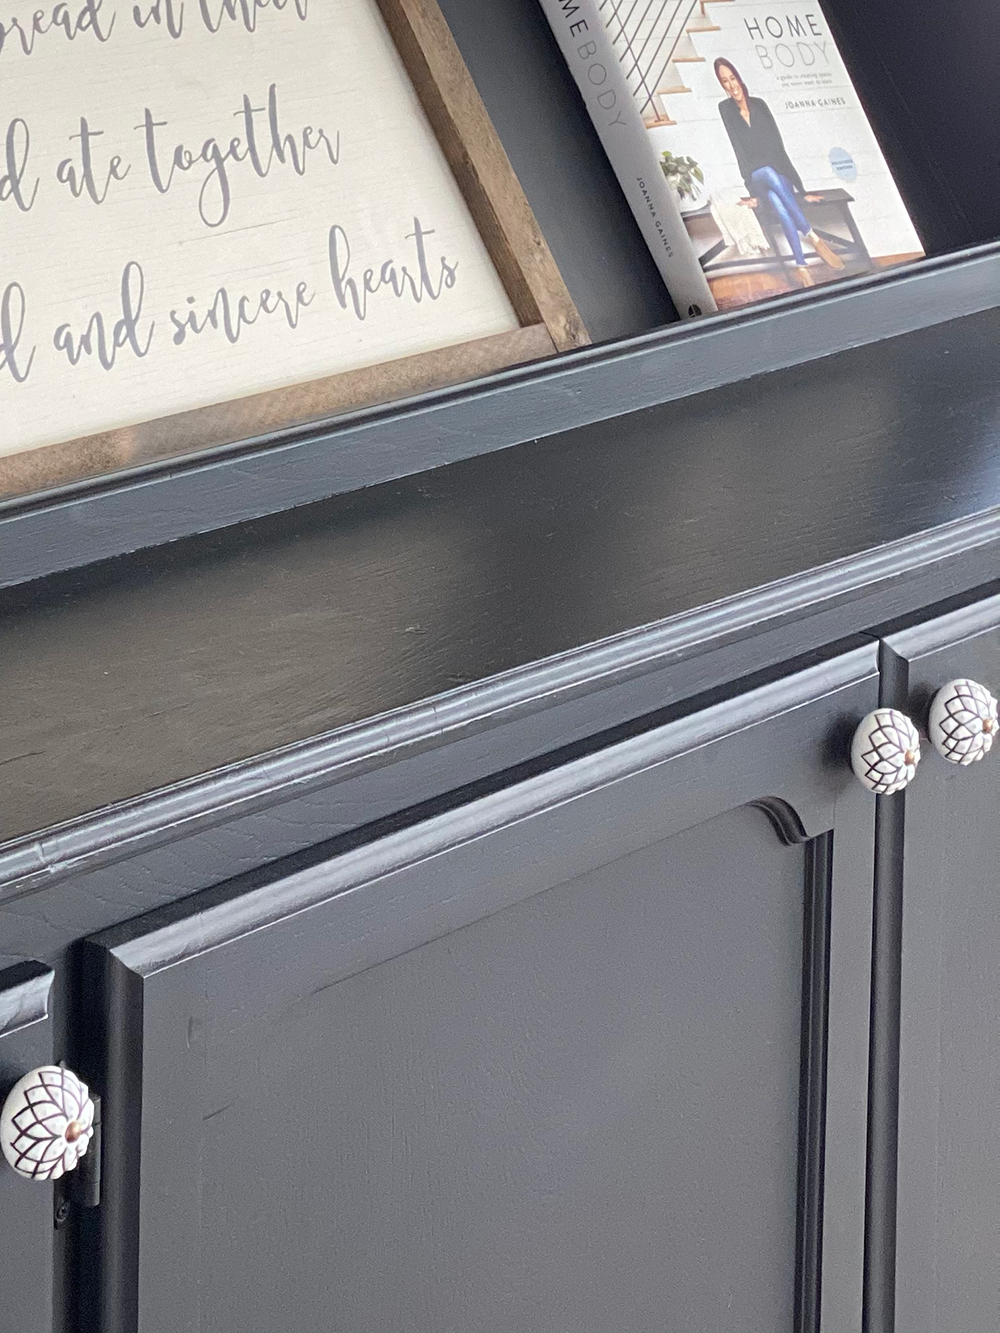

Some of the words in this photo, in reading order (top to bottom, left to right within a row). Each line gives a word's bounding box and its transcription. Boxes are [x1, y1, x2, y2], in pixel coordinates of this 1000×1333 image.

[743, 13, 823, 41] HOME
[754, 40, 831, 70] BODY
[576, 40, 628, 127] BODY
[785, 98, 817, 110] JOANNA
[817, 96, 847, 107] GAINES
[56, 116, 132, 205] ate
[133, 82, 340, 228] together
[637, 176, 657, 218] JOANNA
[654, 220, 674, 259] GAINES
[53, 260, 156, 371] and
[168, 281, 316, 344] sincere
[328, 216, 459, 322] hearts
